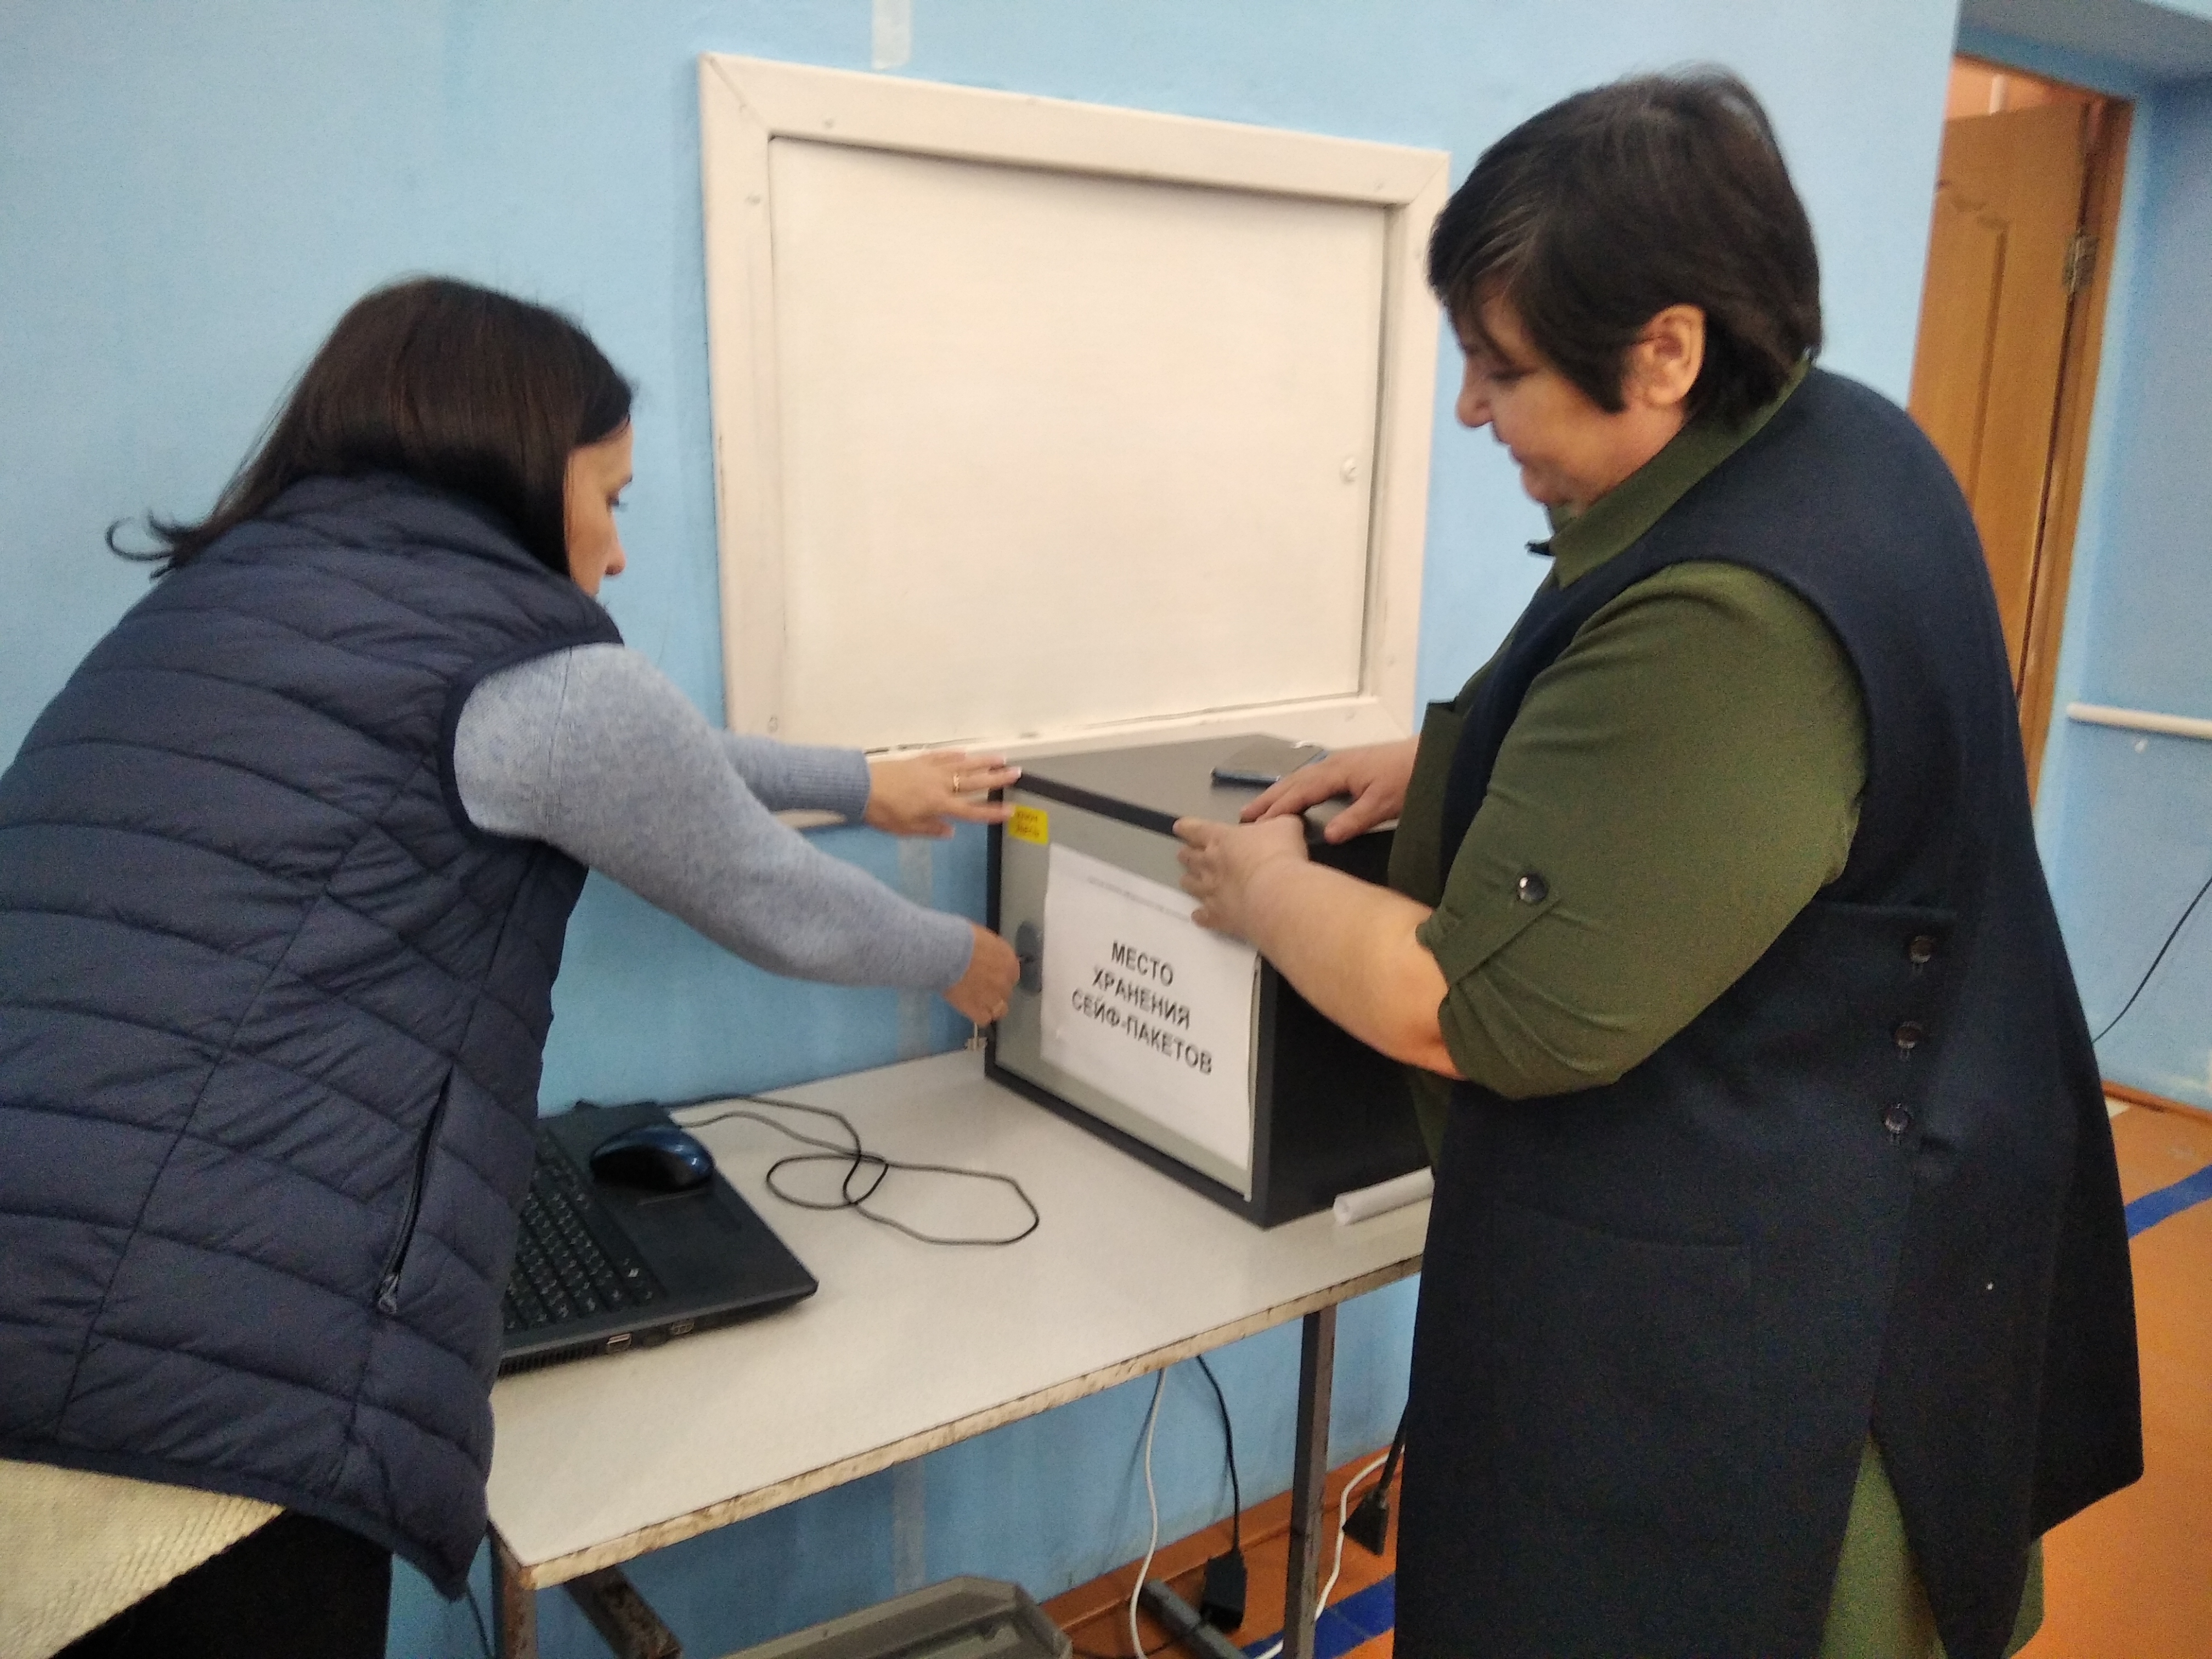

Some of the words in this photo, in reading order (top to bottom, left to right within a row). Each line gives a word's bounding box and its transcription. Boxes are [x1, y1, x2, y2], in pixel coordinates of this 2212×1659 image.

[1111, 940, 1174, 986] МЕСТО
[1092, 966, 1190, 1030] ХРАНЕНИЯ
[1071, 988, 1212, 1075] СЕЙФ-ПАКЕТОВ
